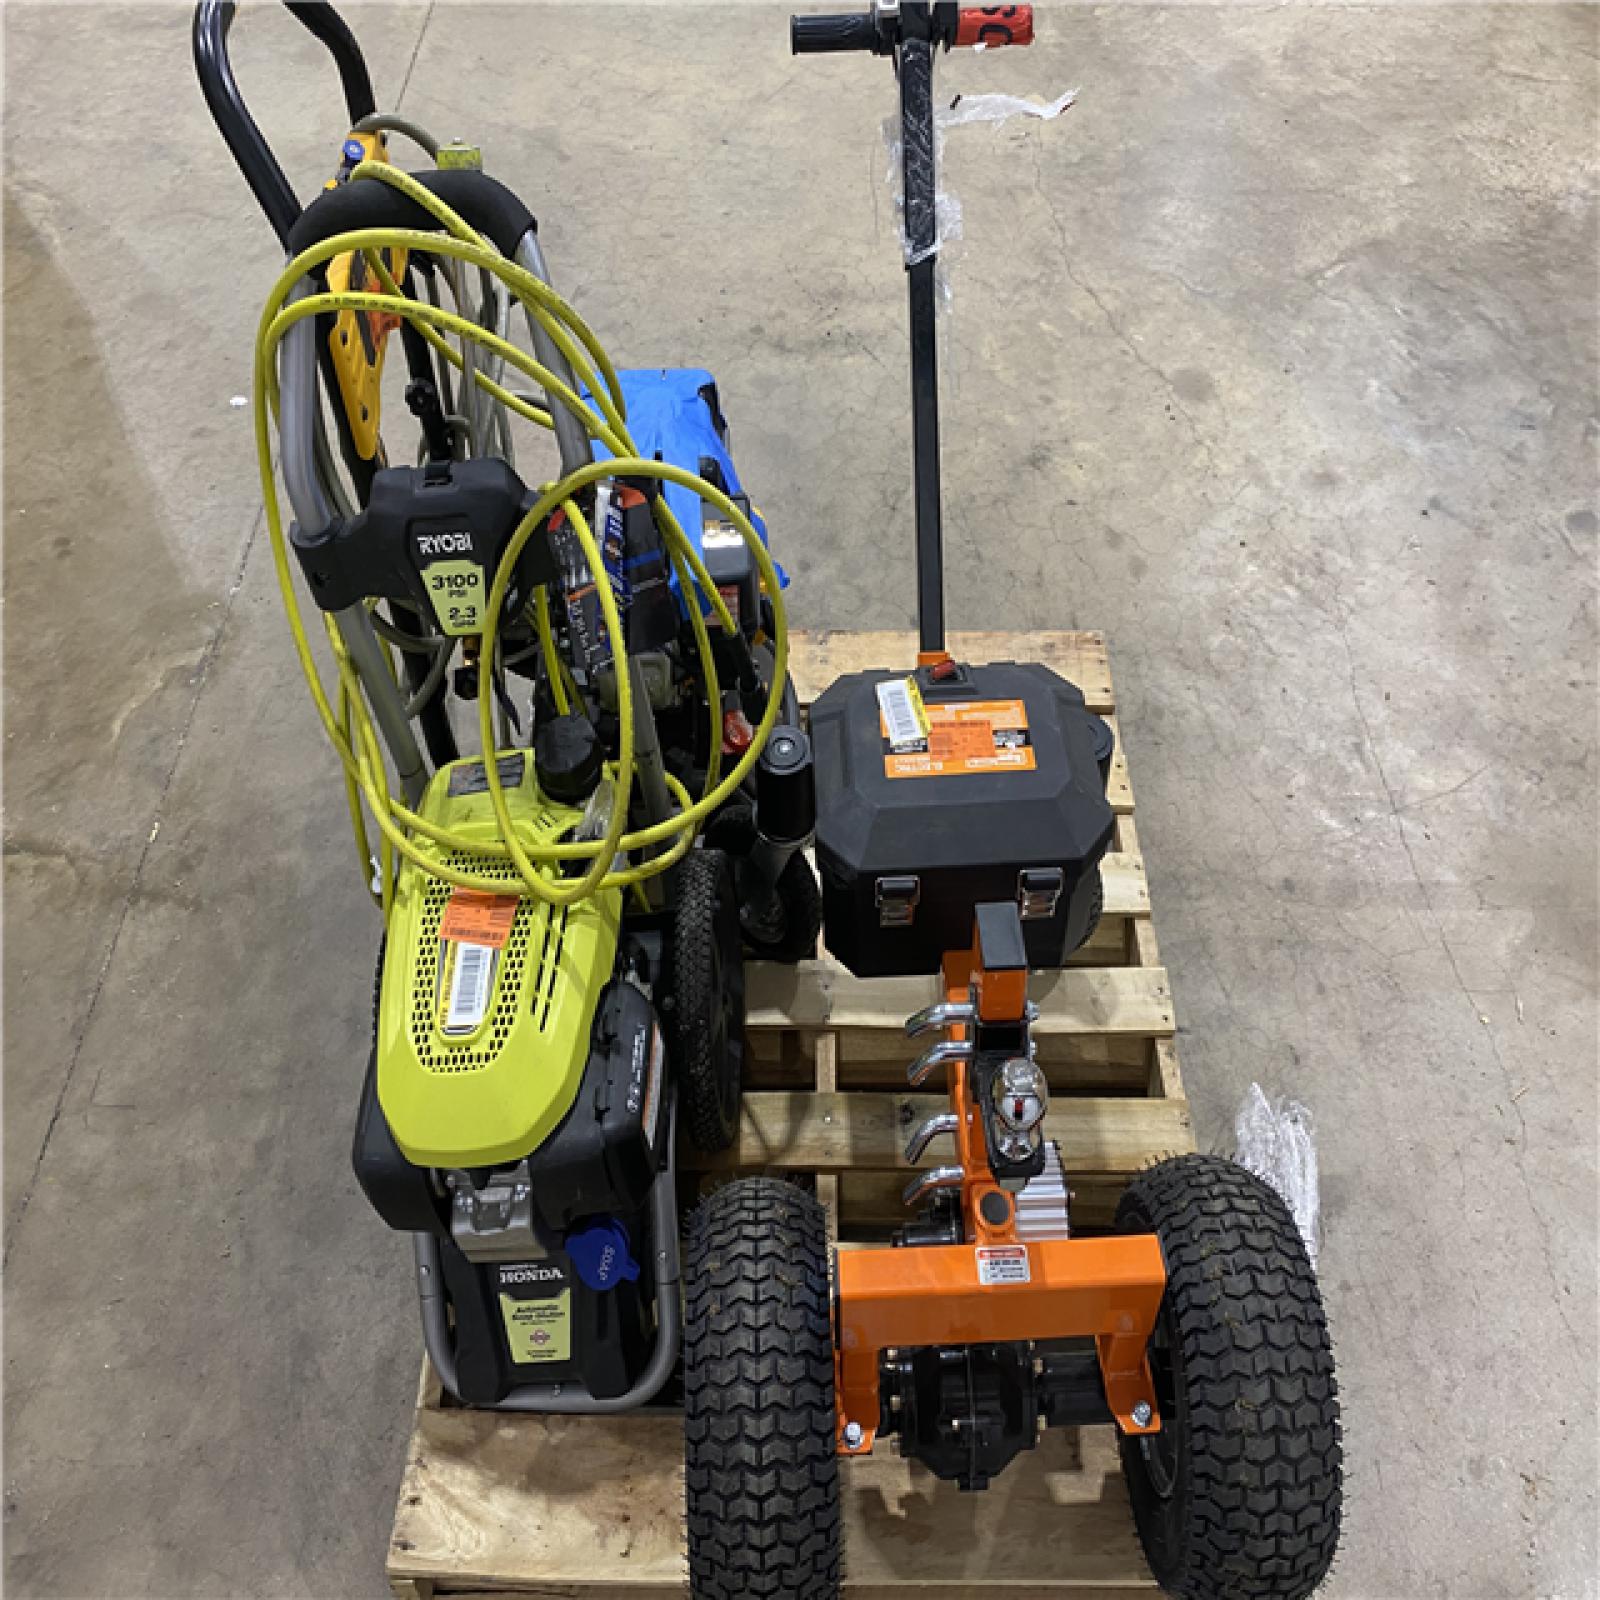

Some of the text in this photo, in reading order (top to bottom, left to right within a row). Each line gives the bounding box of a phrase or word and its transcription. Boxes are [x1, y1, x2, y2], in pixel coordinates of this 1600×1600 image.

[417, 533, 473, 554] RYOBI
[432, 573, 478, 590] 3100
[500, 1267, 564, 1283] HONDA
